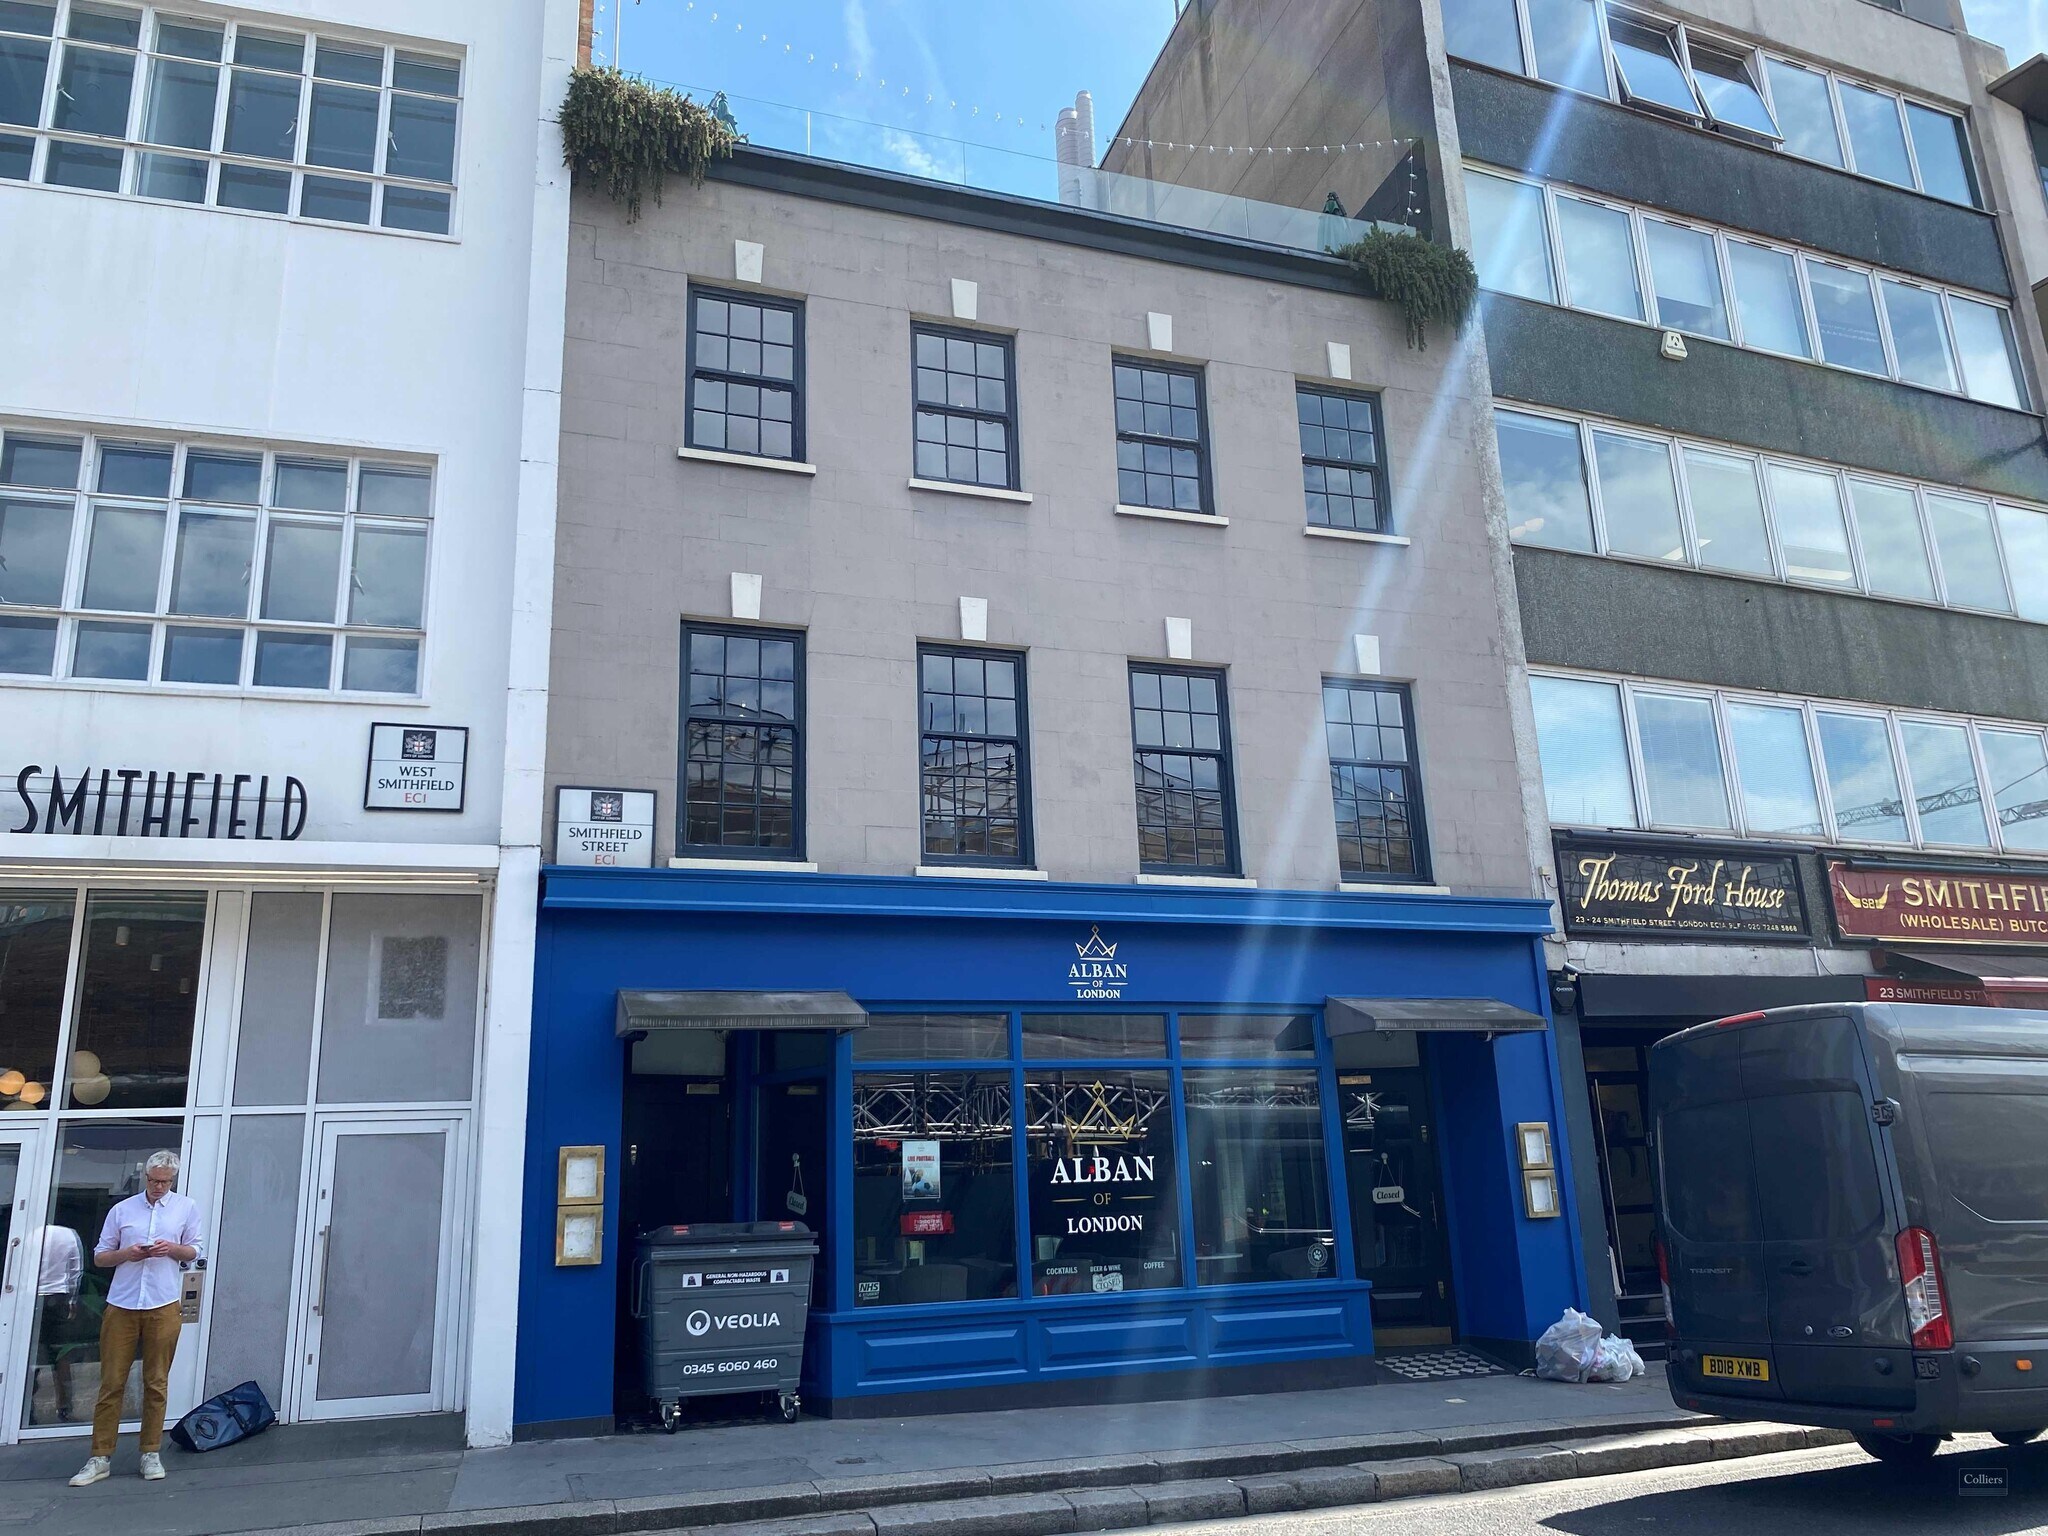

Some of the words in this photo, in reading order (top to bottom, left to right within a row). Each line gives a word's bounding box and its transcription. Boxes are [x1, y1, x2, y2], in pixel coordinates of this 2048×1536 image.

[399, 765, 436, 777] WEST
[378, 778, 455, 791] SMITHFIELD
[10, 764, 308, 841] SMITHFIELD
[404, 792, 427, 804] EC1
[568, 827, 643, 840] SMITHFIELD
[581, 840, 629, 853] STREET
[594, 854, 616, 865] EC1
[1578, 850, 1663, 909] Thomas
[1665, 859, 1724, 918] Ford
[1722, 865, 1785, 909] House
[1603, 918, 1647, 926] SMITHFIELD
[1649, 919, 1676, 927] STREET
[1678, 920, 1709, 928] LONDON
[1900, 913, 2004, 932] (WHOLESALE)
[2009, 919, 2048, 933] BUTC
[1068, 963, 1128, 978] ALBAN
[1092, 980, 1103, 988] OF
[1076, 989, 1121, 999] LONDON
[1879, 987, 1895, 999] 23
[1896, 988, 1962, 1001] SMITHFIELD
[1050, 1155, 1155, 1184] ALBAN
[1093, 1192, 1112, 1205] OF
[1376, 1190, 1400, 1200] Closed
[1066, 1215, 1143, 1234] LONDON
[1046, 1266, 1078, 1275] COCKTAILS
[1089, 1265, 1103, 1273] BEER
[1143, 1261, 1165, 1269] COFFEE
[859, 1283, 879, 1291] NHS
[1095, 1278, 1121, 1290] CLOSED
[714, 1312, 781, 1330] VEOLIA
[683, 1363, 715, 1375] 0345
[718, 1360, 750, 1373] 6060
[753, 1358, 778, 1370] 460
[1709, 1358, 1734, 1375] BD18
[1736, 1360, 1761, 1377] XWB
